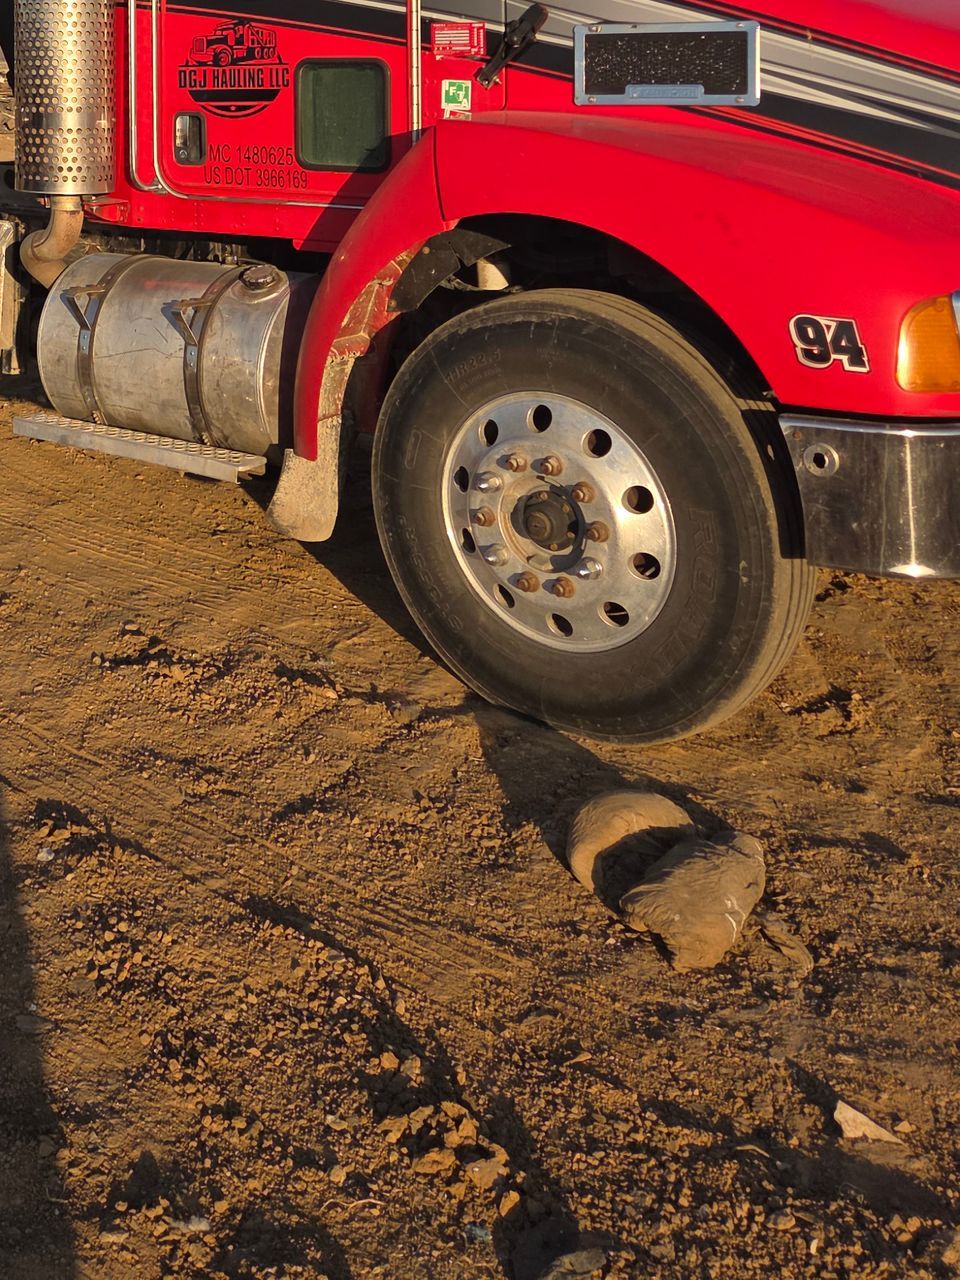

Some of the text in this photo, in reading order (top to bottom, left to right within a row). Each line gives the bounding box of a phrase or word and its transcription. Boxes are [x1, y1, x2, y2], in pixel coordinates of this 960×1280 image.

[212, 67, 264, 89] HAULING
[269, 67, 290, 88] LLC
[209, 143, 294, 166] MC 1480625
[204, 166, 308, 189] US DOT 3966169
[790, 314, 869, 373] 94
